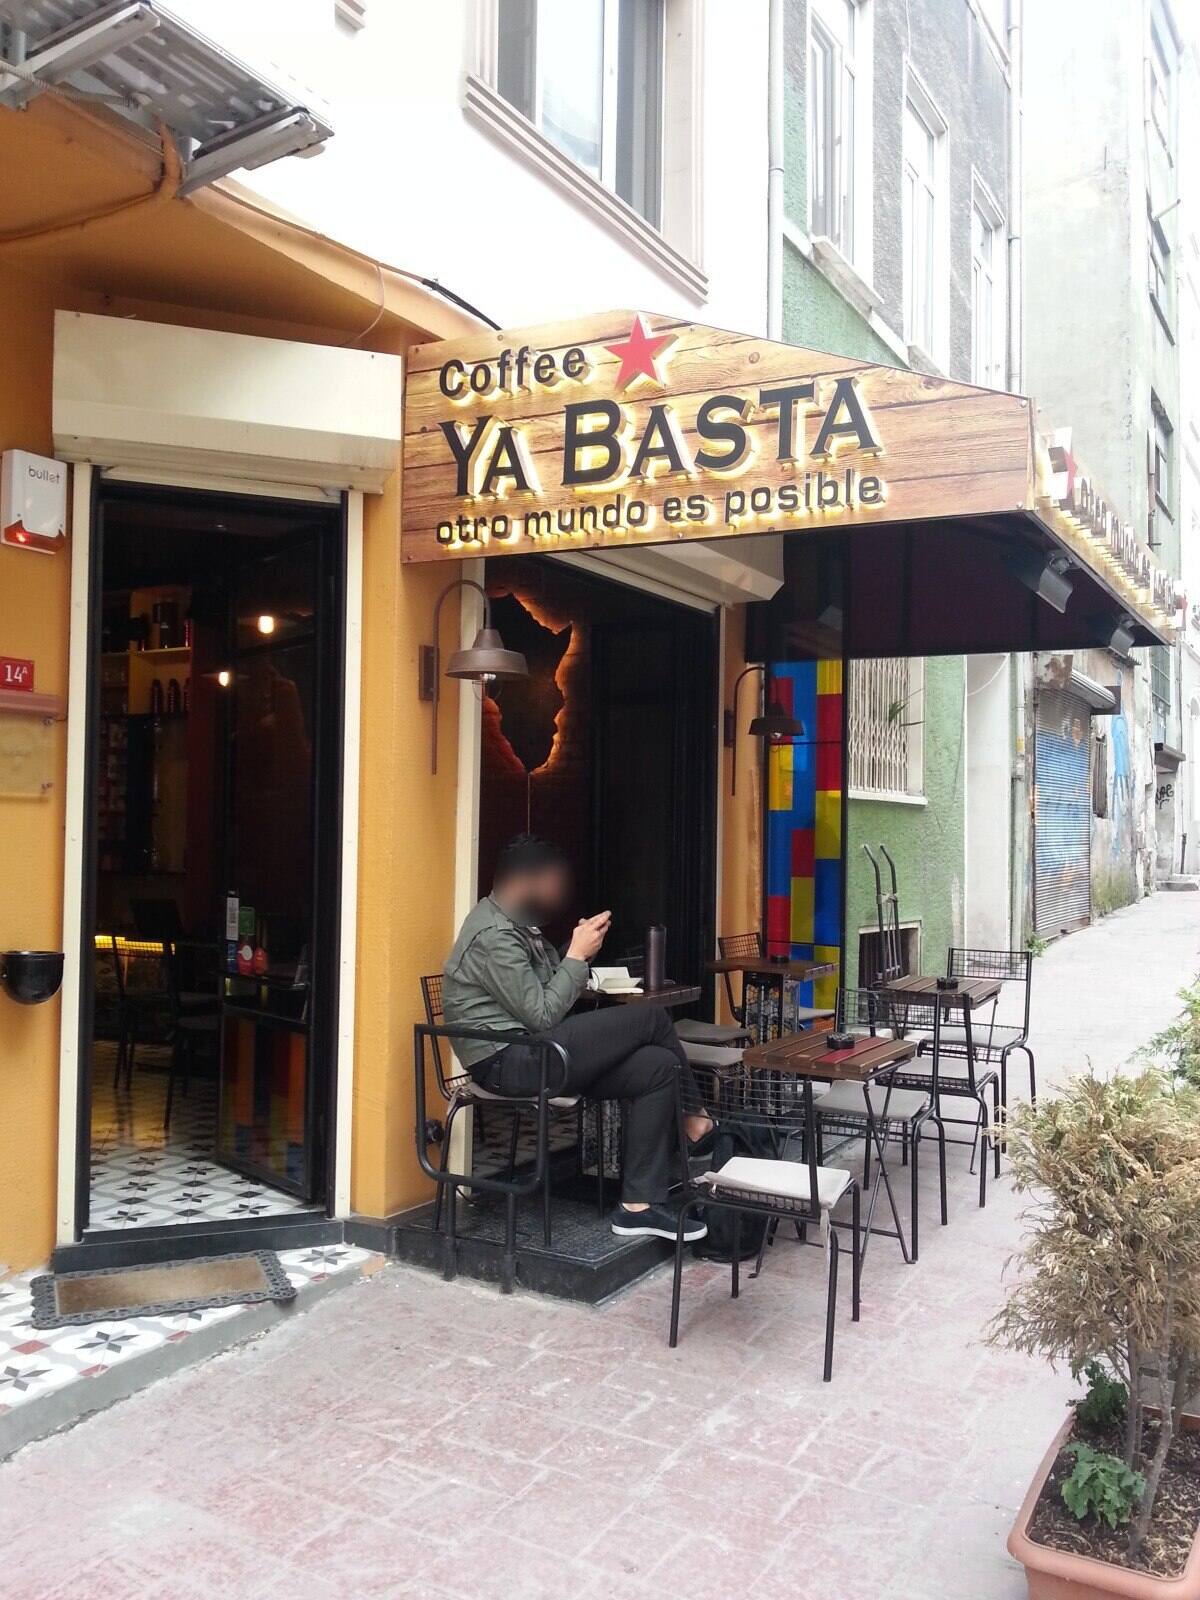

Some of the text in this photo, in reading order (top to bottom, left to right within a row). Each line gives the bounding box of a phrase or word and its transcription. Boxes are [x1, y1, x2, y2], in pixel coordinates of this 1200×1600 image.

[440, 346, 587, 397] Coffee
[437, 376, 880, 497] YA BASTA
[28, 464, 60, 484] bullet
[436, 466, 883, 545] otro mundo es posible
